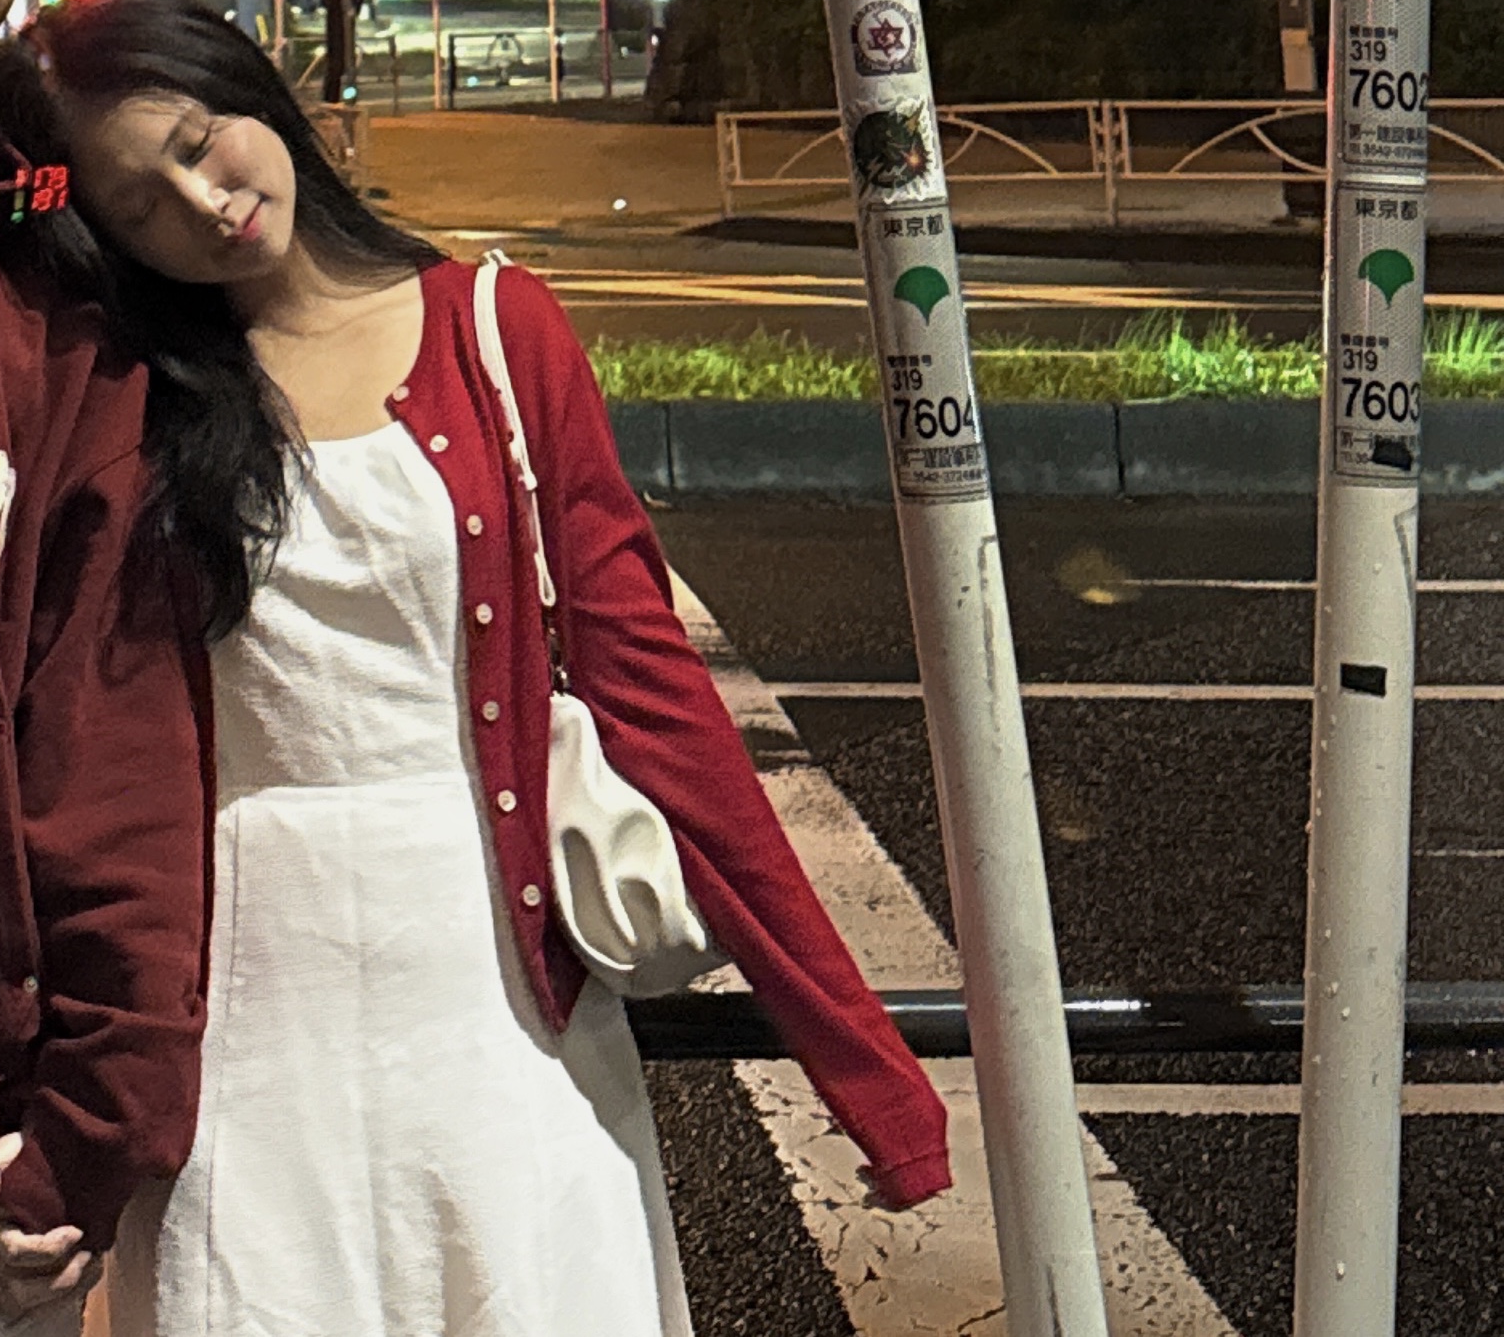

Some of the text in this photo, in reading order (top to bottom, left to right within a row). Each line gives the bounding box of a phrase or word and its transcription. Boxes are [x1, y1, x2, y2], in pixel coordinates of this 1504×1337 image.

[1350, 40, 1387, 62] 319
[1343, 348, 1378, 372] 319
[892, 368, 923, 391] 319
[1341, 377, 1422, 423] 7603
